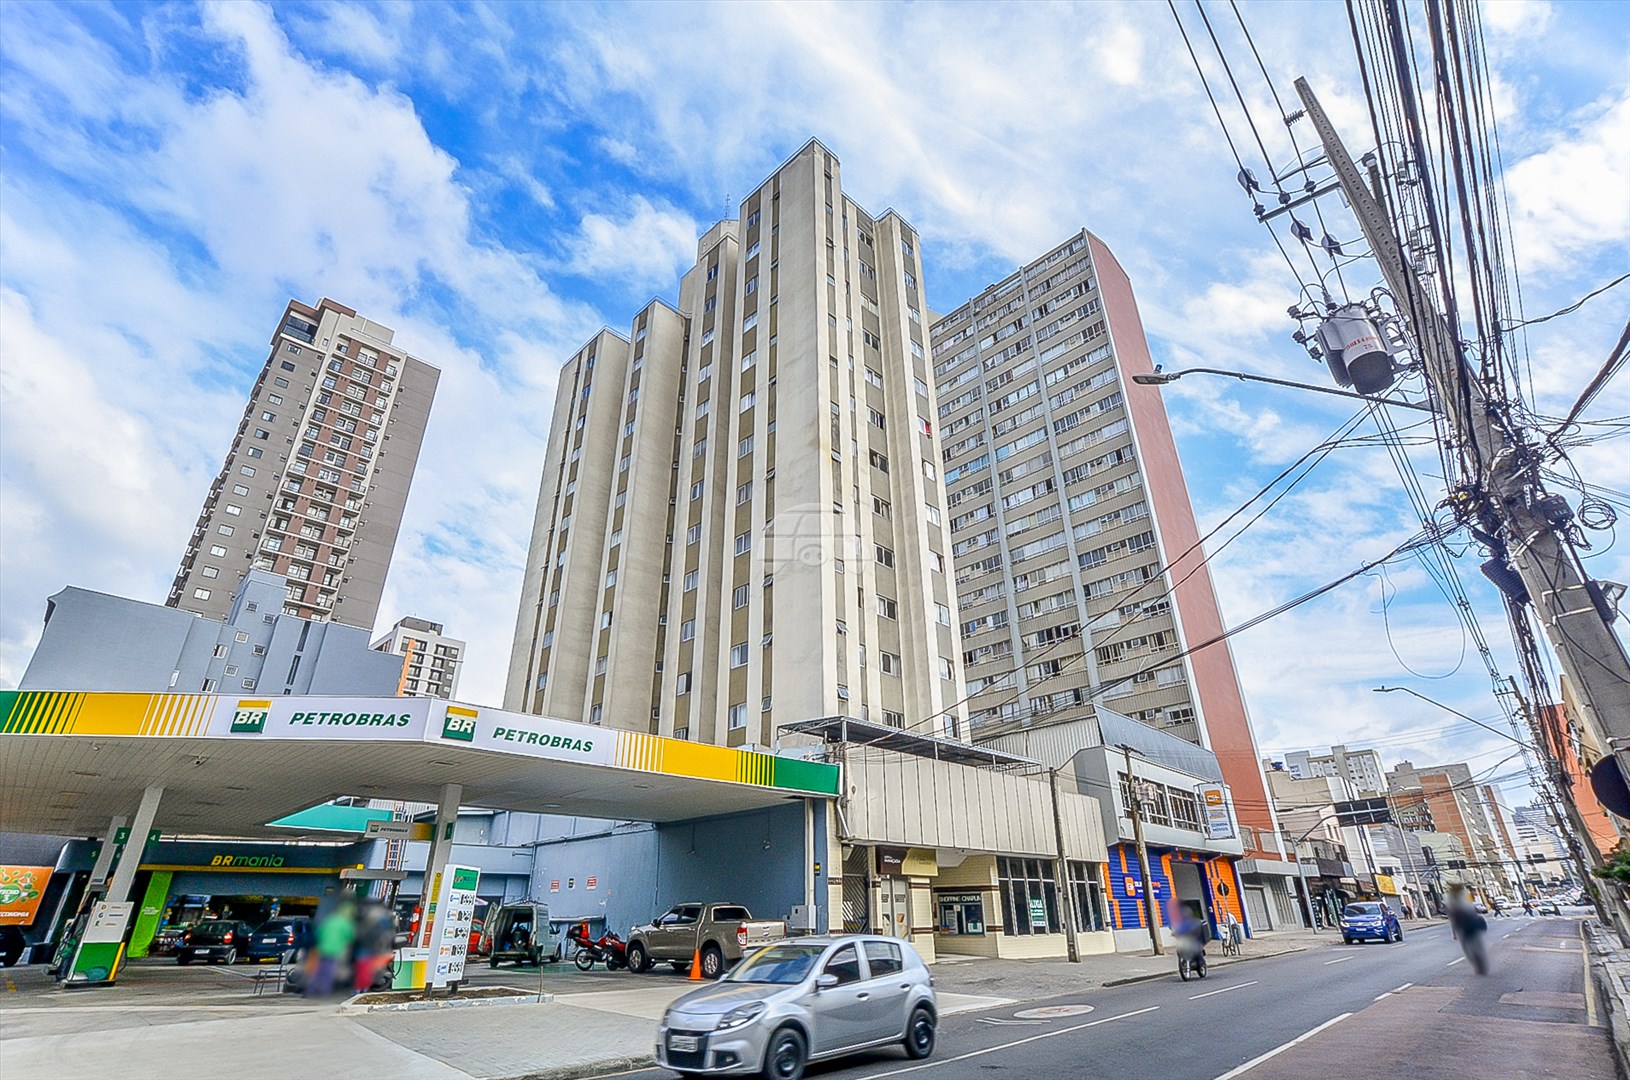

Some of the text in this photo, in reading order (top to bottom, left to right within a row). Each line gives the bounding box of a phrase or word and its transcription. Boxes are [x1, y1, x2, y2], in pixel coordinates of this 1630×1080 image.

[234, 711, 263, 725] BR
[289, 712, 411, 727] PETROBRAS
[446, 718, 475, 734] BR
[492, 727, 594, 752] PETROBRAS
[120, 832, 126, 840] 3
[211, 854, 284, 867] BRmania
